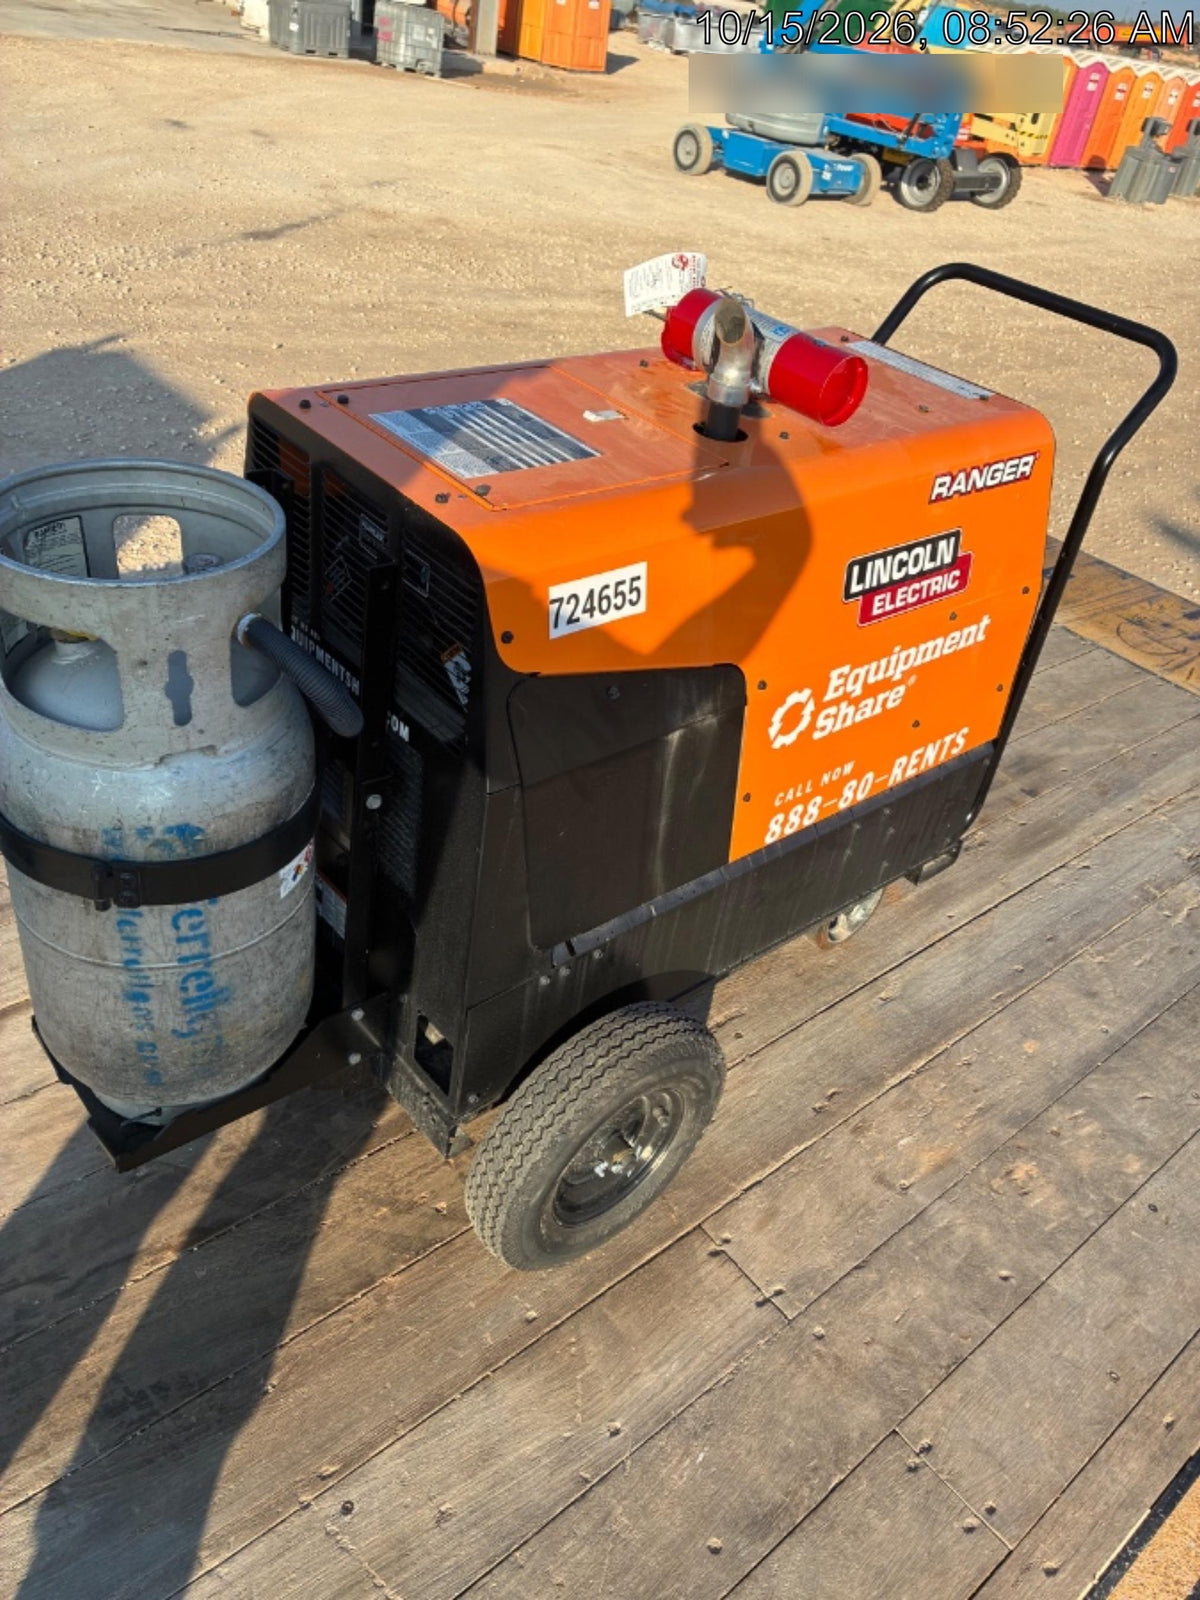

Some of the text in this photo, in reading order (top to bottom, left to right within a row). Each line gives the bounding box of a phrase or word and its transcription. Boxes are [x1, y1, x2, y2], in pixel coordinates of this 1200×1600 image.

[930, 453, 1037, 502] RANGER
[850, 536, 956, 595] LINCOLN
[871, 569, 961, 617] ELECTRIC
[549, 574, 641, 630] 724655
[822, 614, 992, 702] Equipment
[812, 683, 906, 741] Share
[764, 727, 970, 845] 888-80-RENTS
[774, 760, 856, 808] CALL NOW
